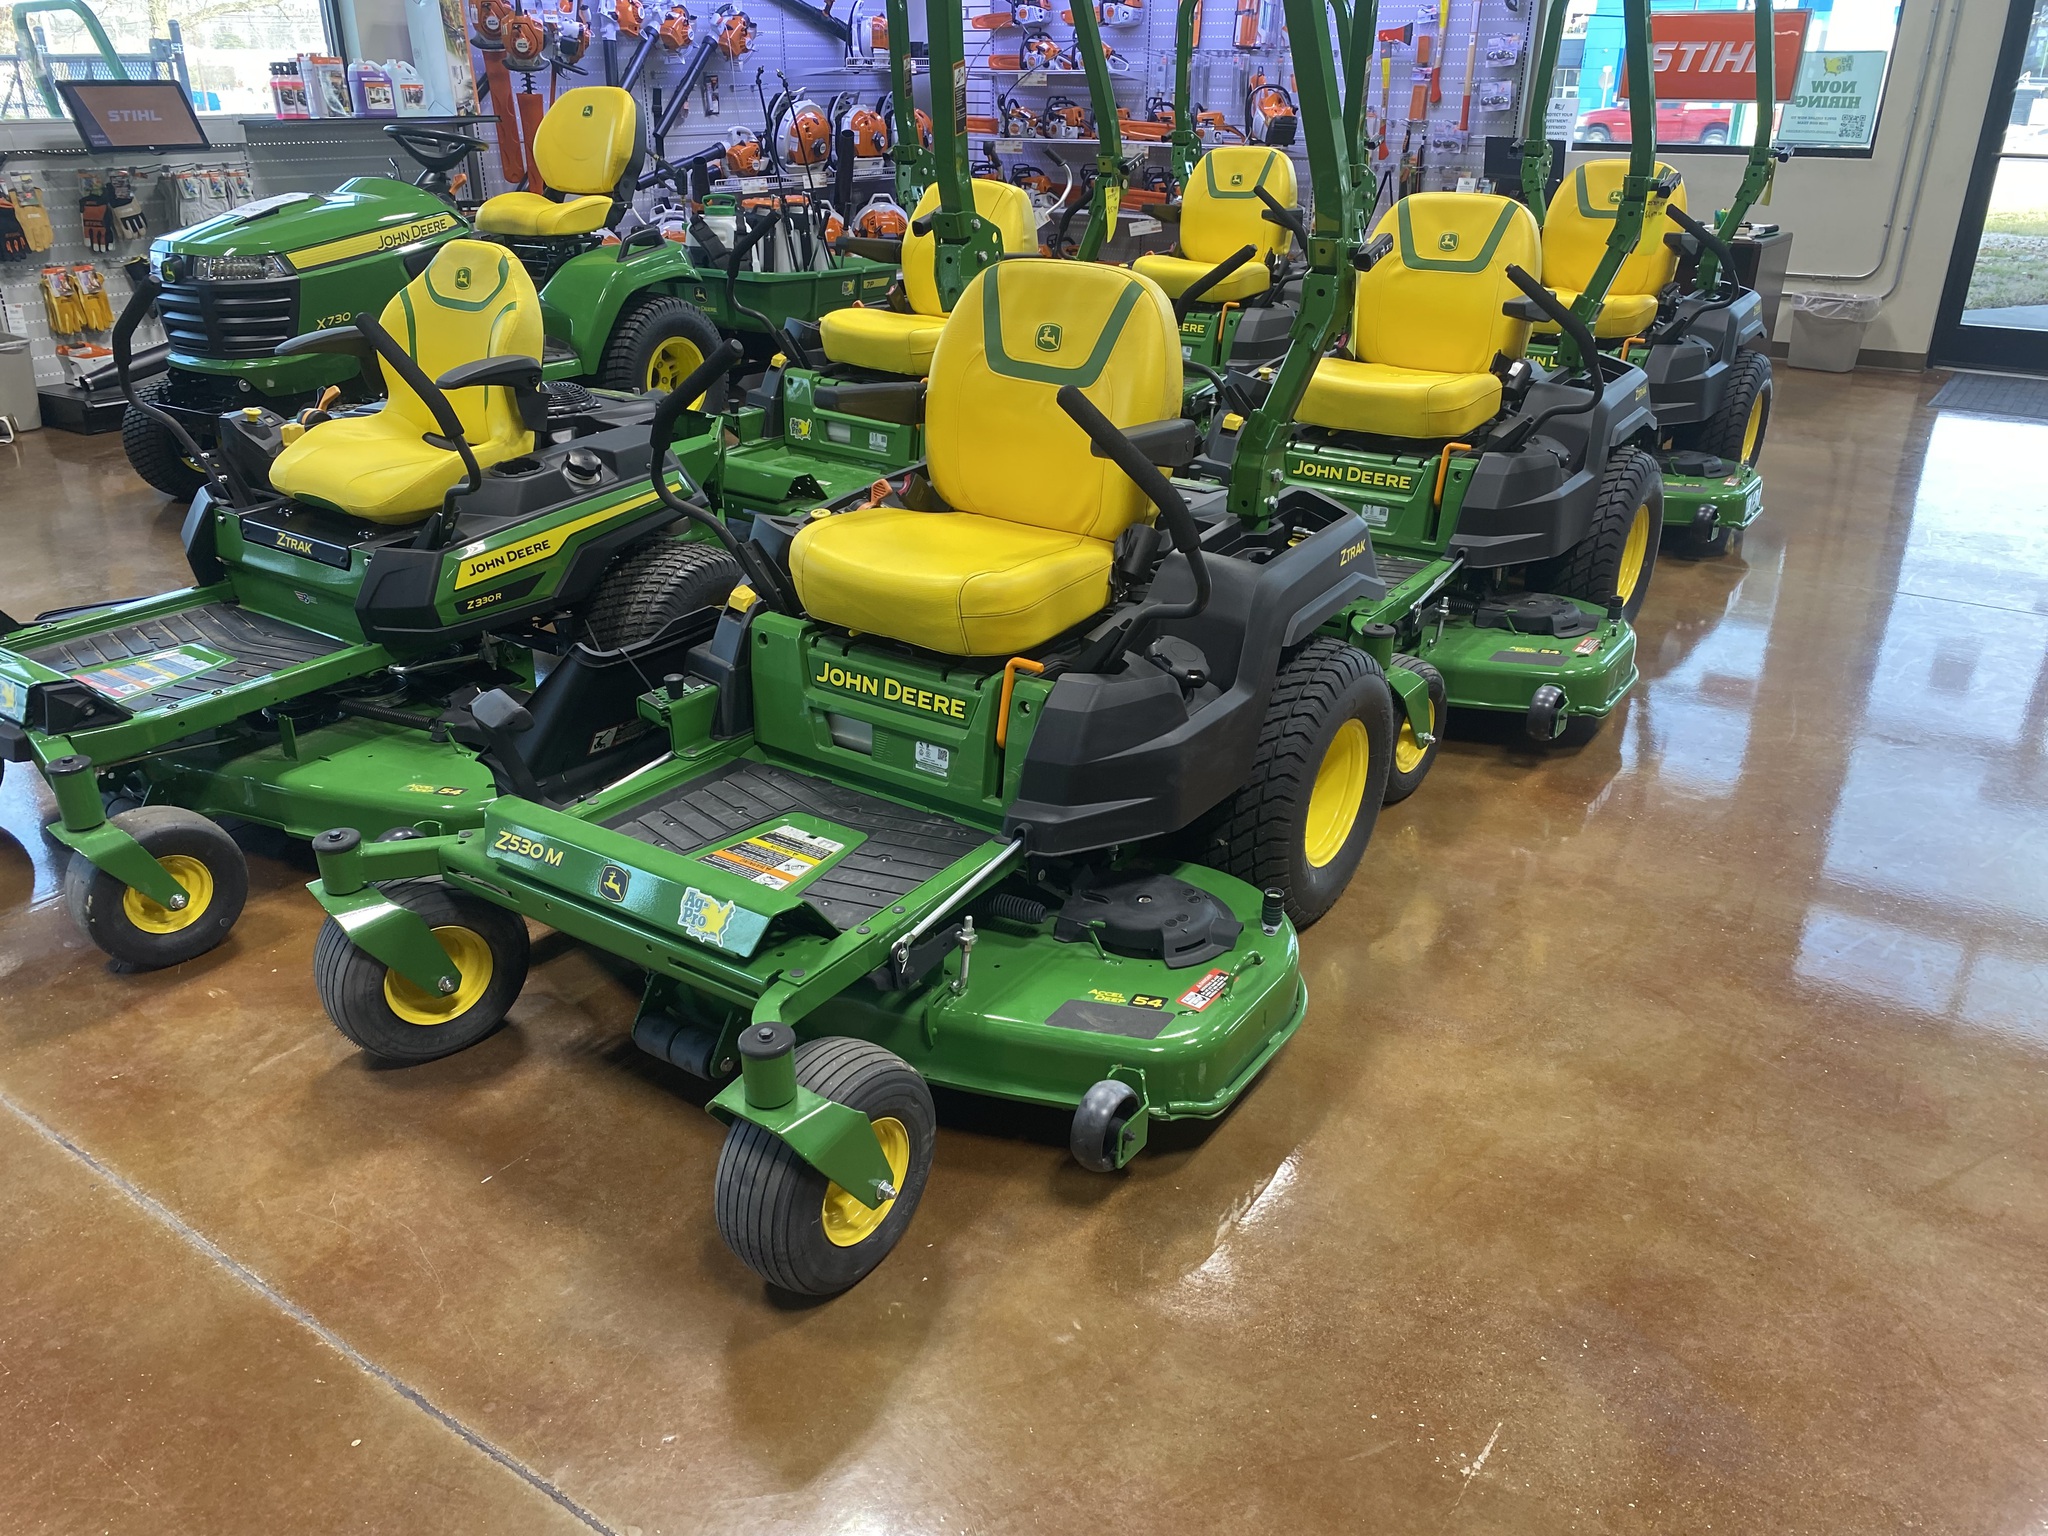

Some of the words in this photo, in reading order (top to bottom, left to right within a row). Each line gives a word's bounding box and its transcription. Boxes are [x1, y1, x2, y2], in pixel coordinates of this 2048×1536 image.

[108, 109, 162, 122] STIHL
[378, 230, 410, 250] JOHN
[410, 219, 447, 238] DEERE
[316, 312, 351, 331] X730
[1293, 460, 1343, 480] JOHN
[1346, 466, 1412, 489] DEERE
[276, 532, 312, 555] ZTRAK
[1340, 538, 1366, 567] ZTRAK
[469, 558, 505, 577] JOHN
[507, 540, 551, 563] DEERE
[816, 662, 879, 696] JOHN
[883, 677, 966, 720] DEERE
[684, 892, 709, 912] Ag-
[682, 907, 707, 927] Pro
[1088, 989, 1125, 998] ACCEL
[1132, 997, 1163, 1008] 54
[1094, 994, 1127, 1004] DEEP
